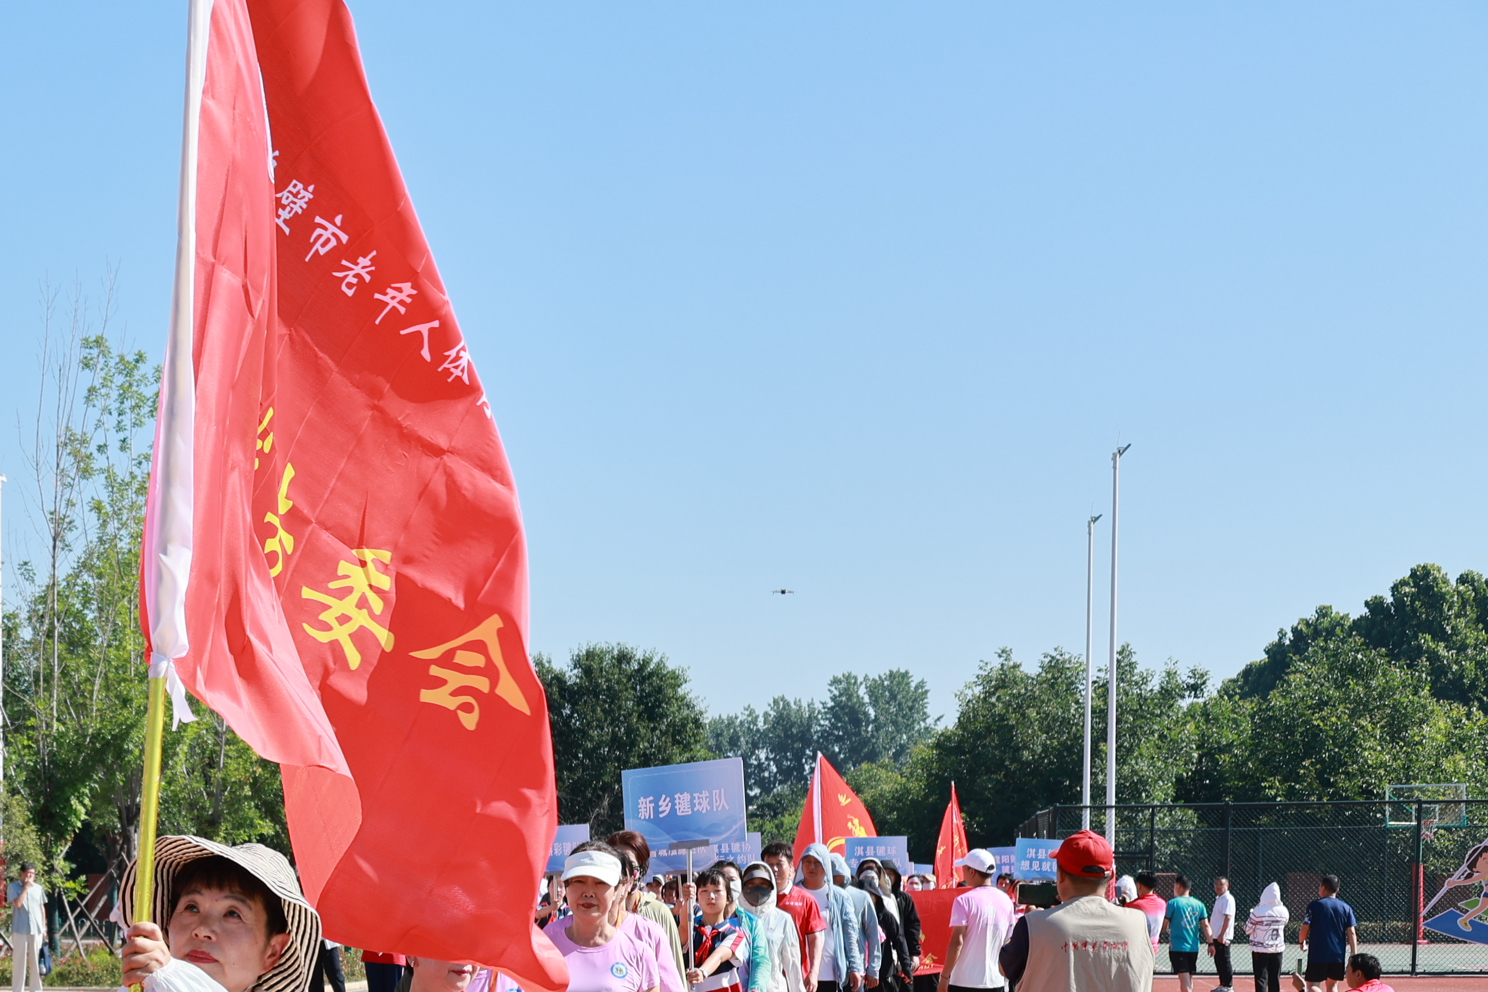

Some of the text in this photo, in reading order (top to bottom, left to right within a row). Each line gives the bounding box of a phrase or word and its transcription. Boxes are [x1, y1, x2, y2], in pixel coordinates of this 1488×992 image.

[268, 149, 491, 419] 壁市老年人体
[637, 787, 730, 821] 新乡毽球队
[854, 845, 898, 857] 淇县毽球
[1026, 847, 1052, 859] 淇县
